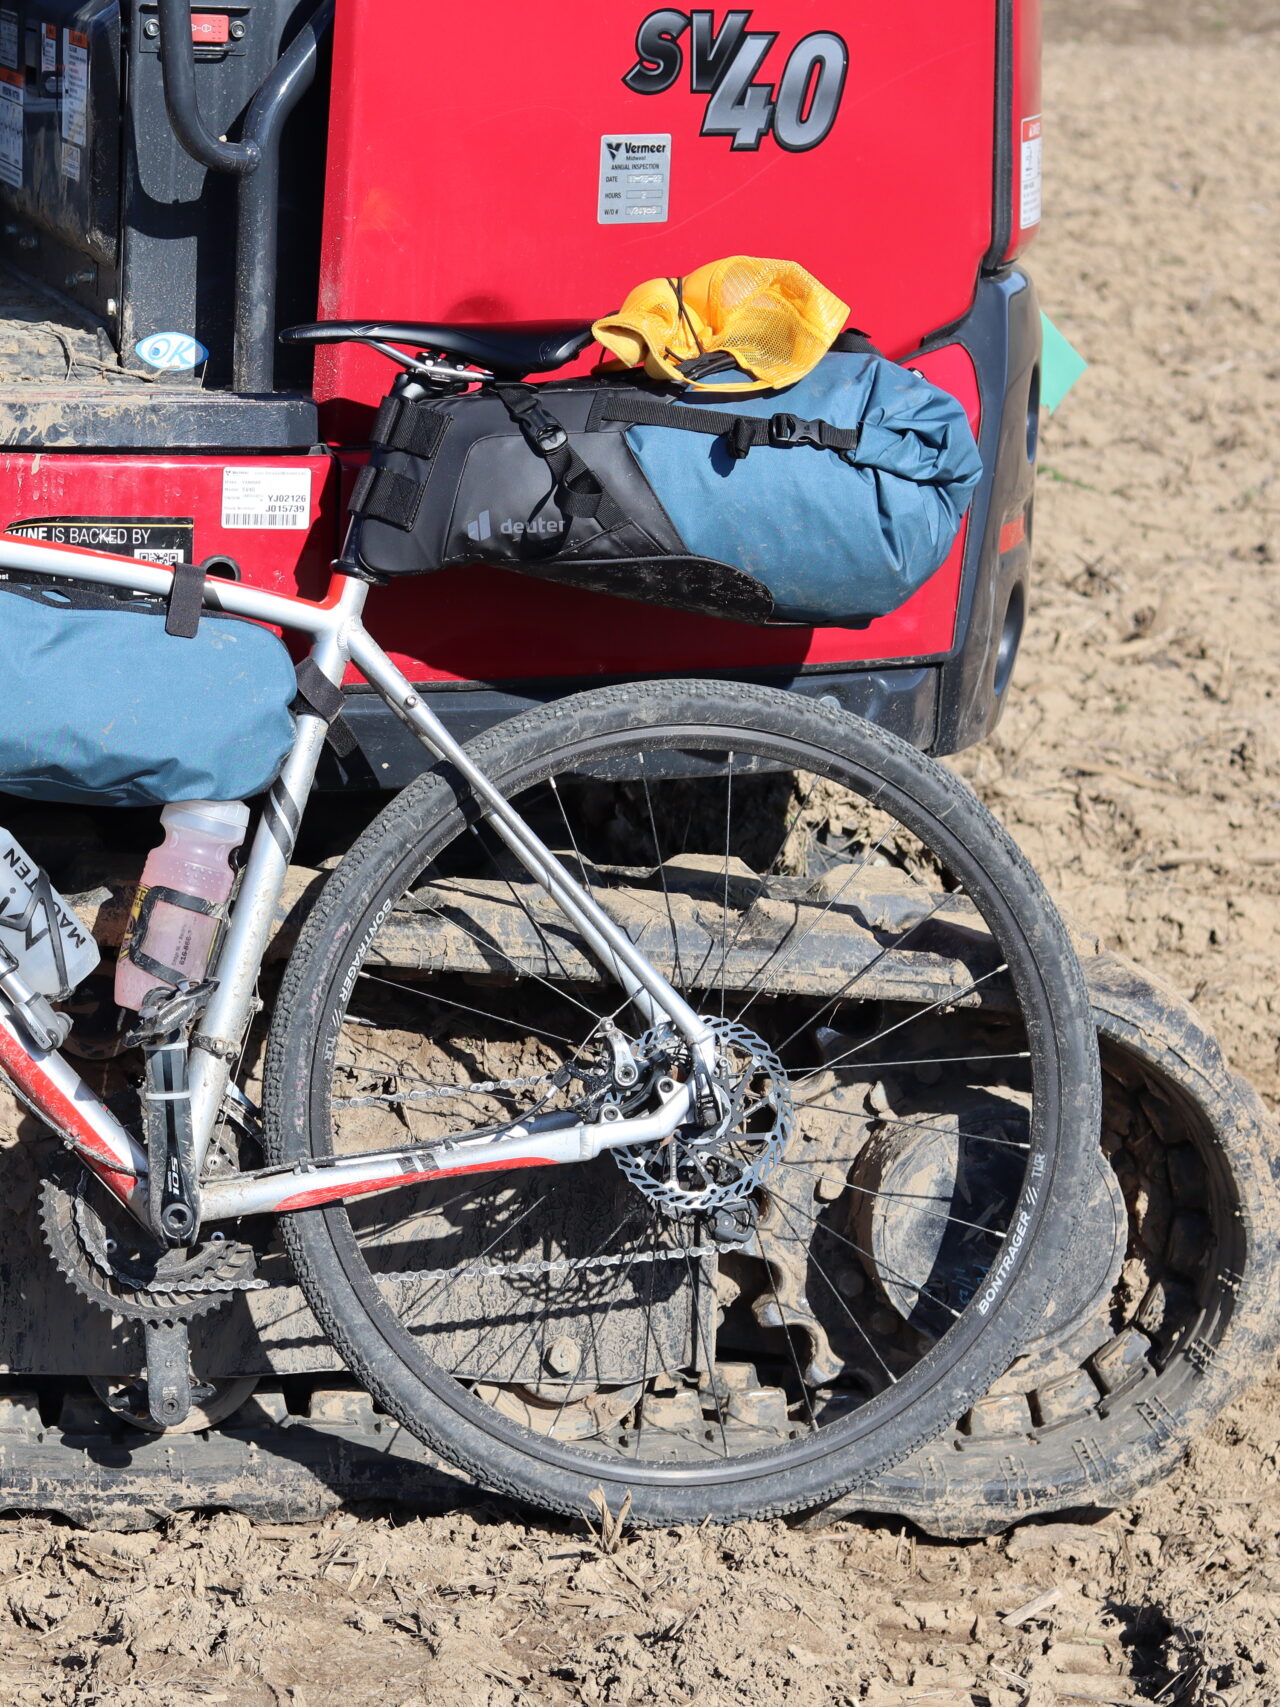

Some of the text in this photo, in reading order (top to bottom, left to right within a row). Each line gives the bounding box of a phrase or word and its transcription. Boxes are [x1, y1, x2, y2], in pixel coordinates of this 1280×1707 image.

[624, 142, 666, 153] Vermeer
[148, 338, 195, 365] OK
[265, 505, 305, 513] J015739
[267, 494, 306, 503] YJ02126
[51, 527, 65, 543] IS
[69, 527, 128, 544] BACKED
[132, 528, 151, 544] BY
[500, 516, 565, 534] deuter
[3, 848, 87, 949] MAUTEN
[338, 898, 393, 1002] BONTRAGER
[324, 1035, 337, 1061] TLR
[170, 1155, 180, 1196] 105
[978, 1153, 1046, 1317] BONTRAGER TLR
